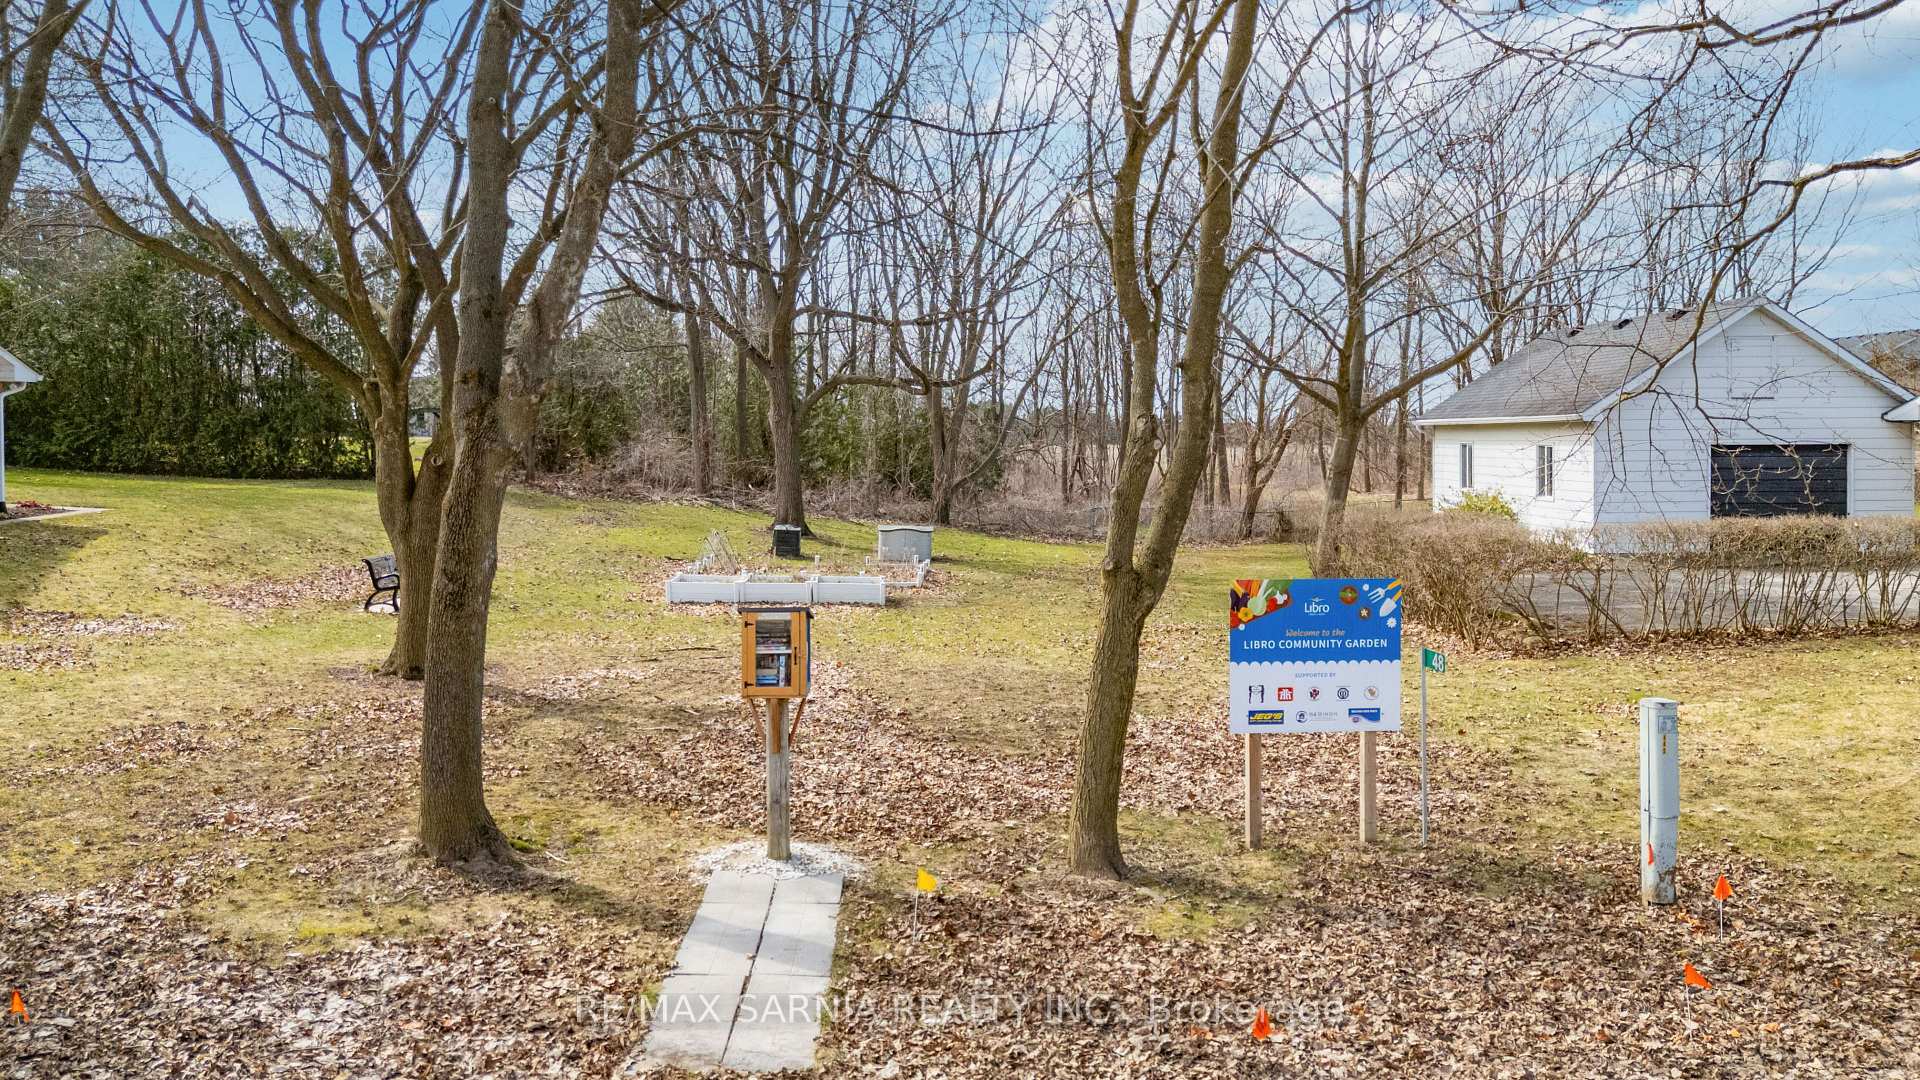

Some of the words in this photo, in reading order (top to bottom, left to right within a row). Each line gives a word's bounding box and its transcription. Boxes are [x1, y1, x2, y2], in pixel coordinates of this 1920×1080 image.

[1304, 602, 1330, 613] Libro
[1243, 640, 1276, 649] LIBRO
[1278, 639, 1342, 649] COMMUNITY
[1345, 638, 1388, 648] GARDEN
